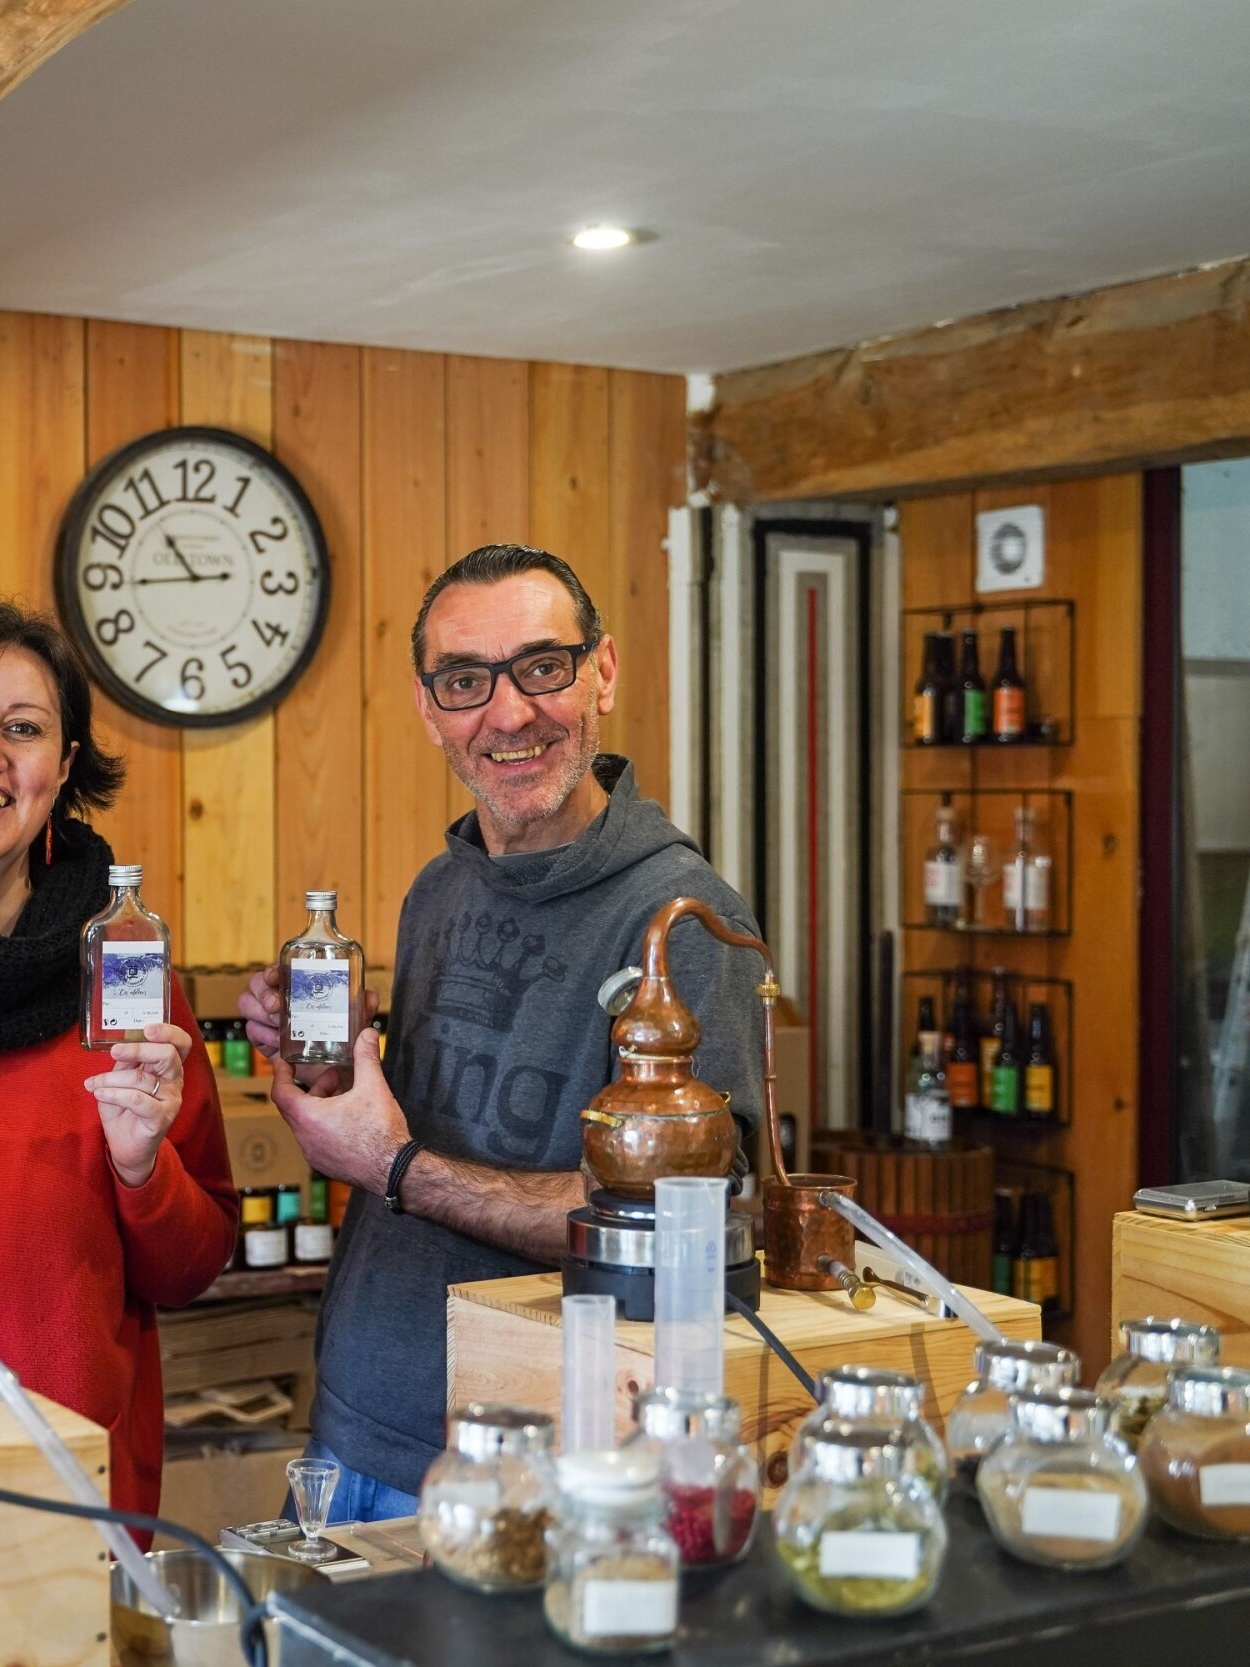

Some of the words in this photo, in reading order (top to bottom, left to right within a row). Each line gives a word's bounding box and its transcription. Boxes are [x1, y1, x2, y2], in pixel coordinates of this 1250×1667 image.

[124, 468, 170, 520] 11
[173, 459, 217, 503] 12
[222, 475, 252, 518] 1
[91, 503, 136, 560] 10
[249, 517, 288, 553] 2
[83, 563, 123, 592] 9
[261, 570, 299, 596] 3
[95, 609, 135, 647] 8
[251, 618, 291, 649] 4
[134, 641, 168, 684] 7
[181, 657, 205, 700] 6
[220, 645, 252, 689] 5
